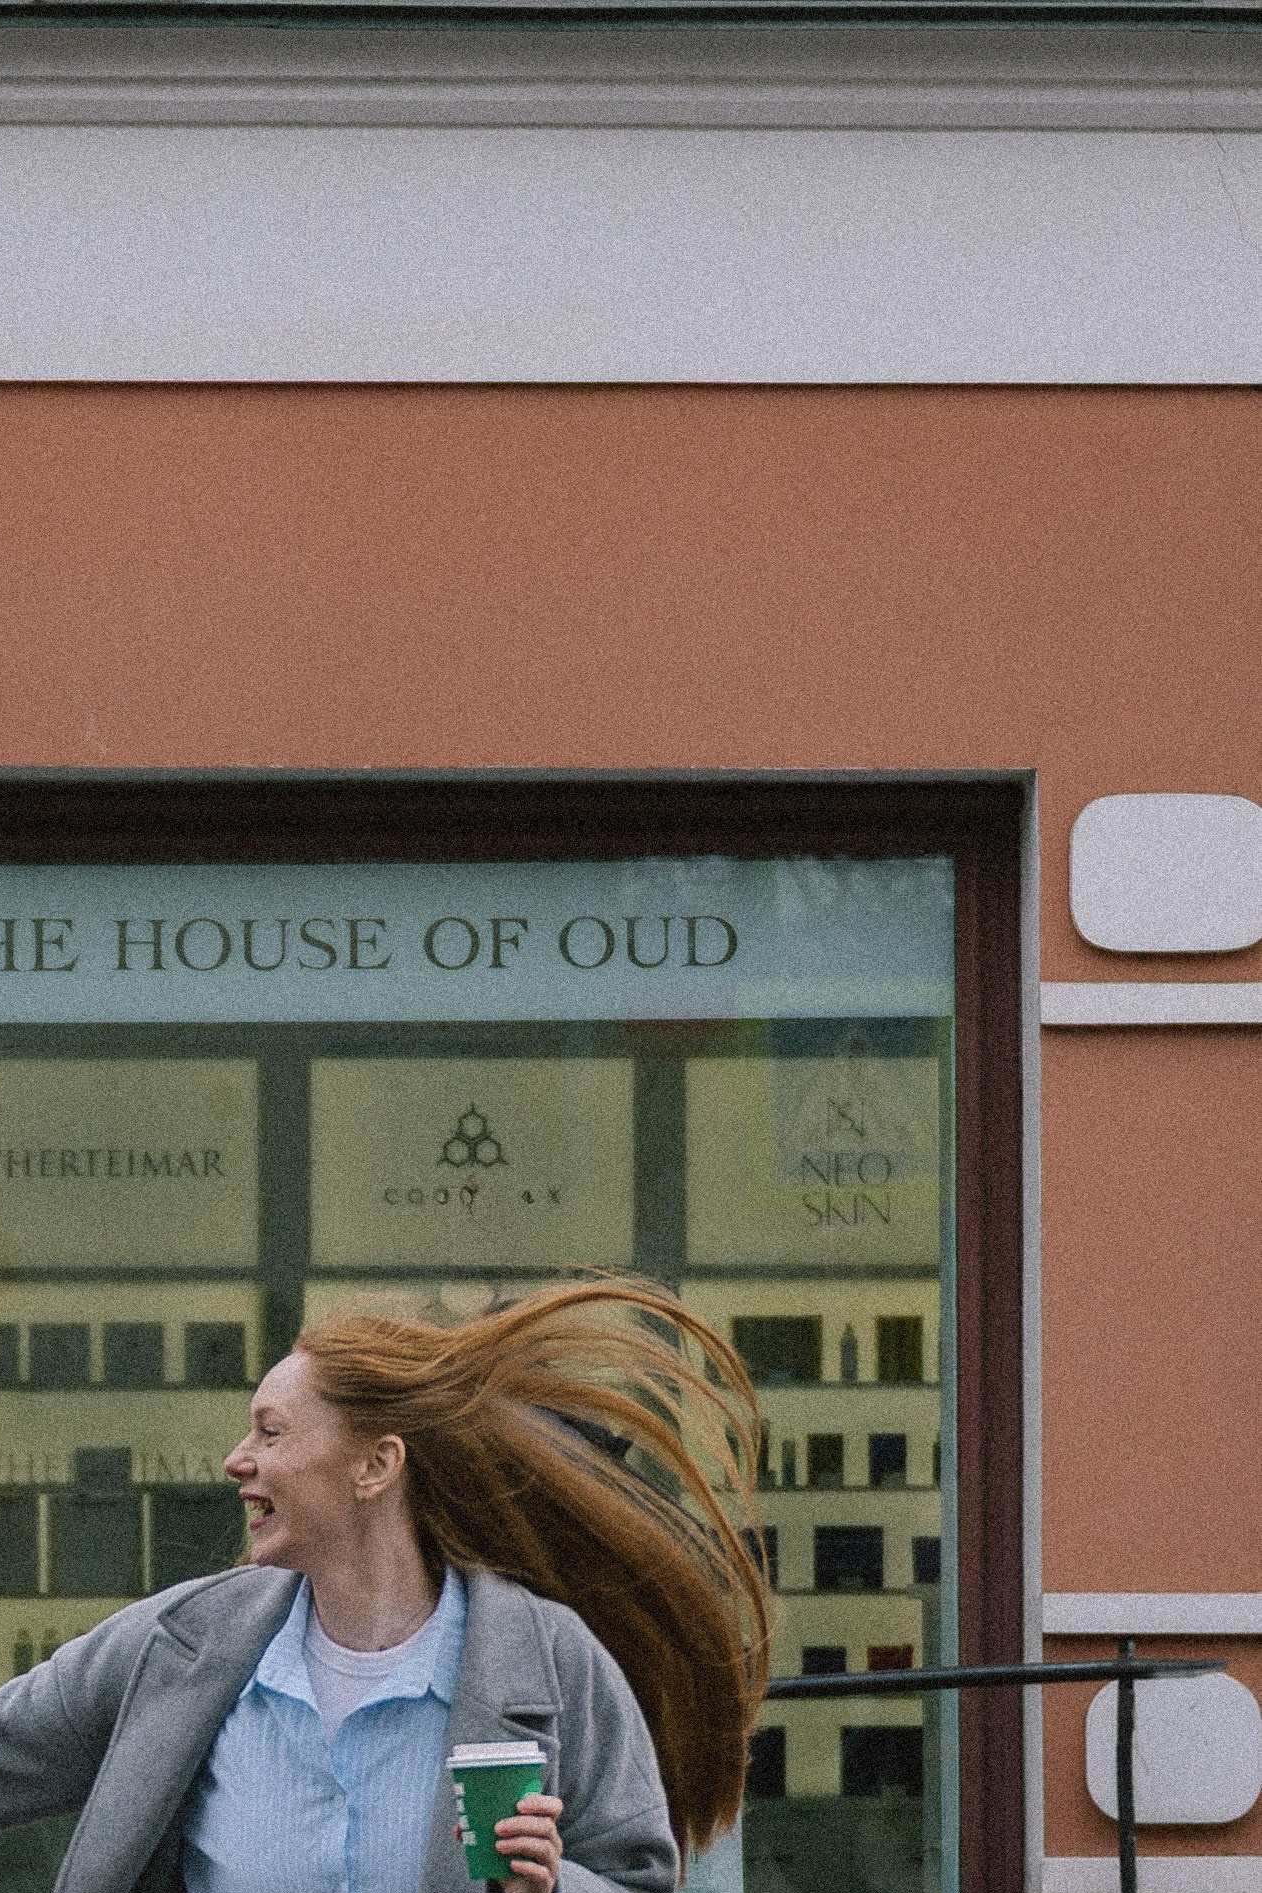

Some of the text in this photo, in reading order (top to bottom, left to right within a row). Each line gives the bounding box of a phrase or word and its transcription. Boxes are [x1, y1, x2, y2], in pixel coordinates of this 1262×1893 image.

[115, 917, 391, 971] HOUSE
[422, 916, 530, 969] OF
[558, 915, 741, 969] OUD
[801, 1191, 891, 1228] SKIN
